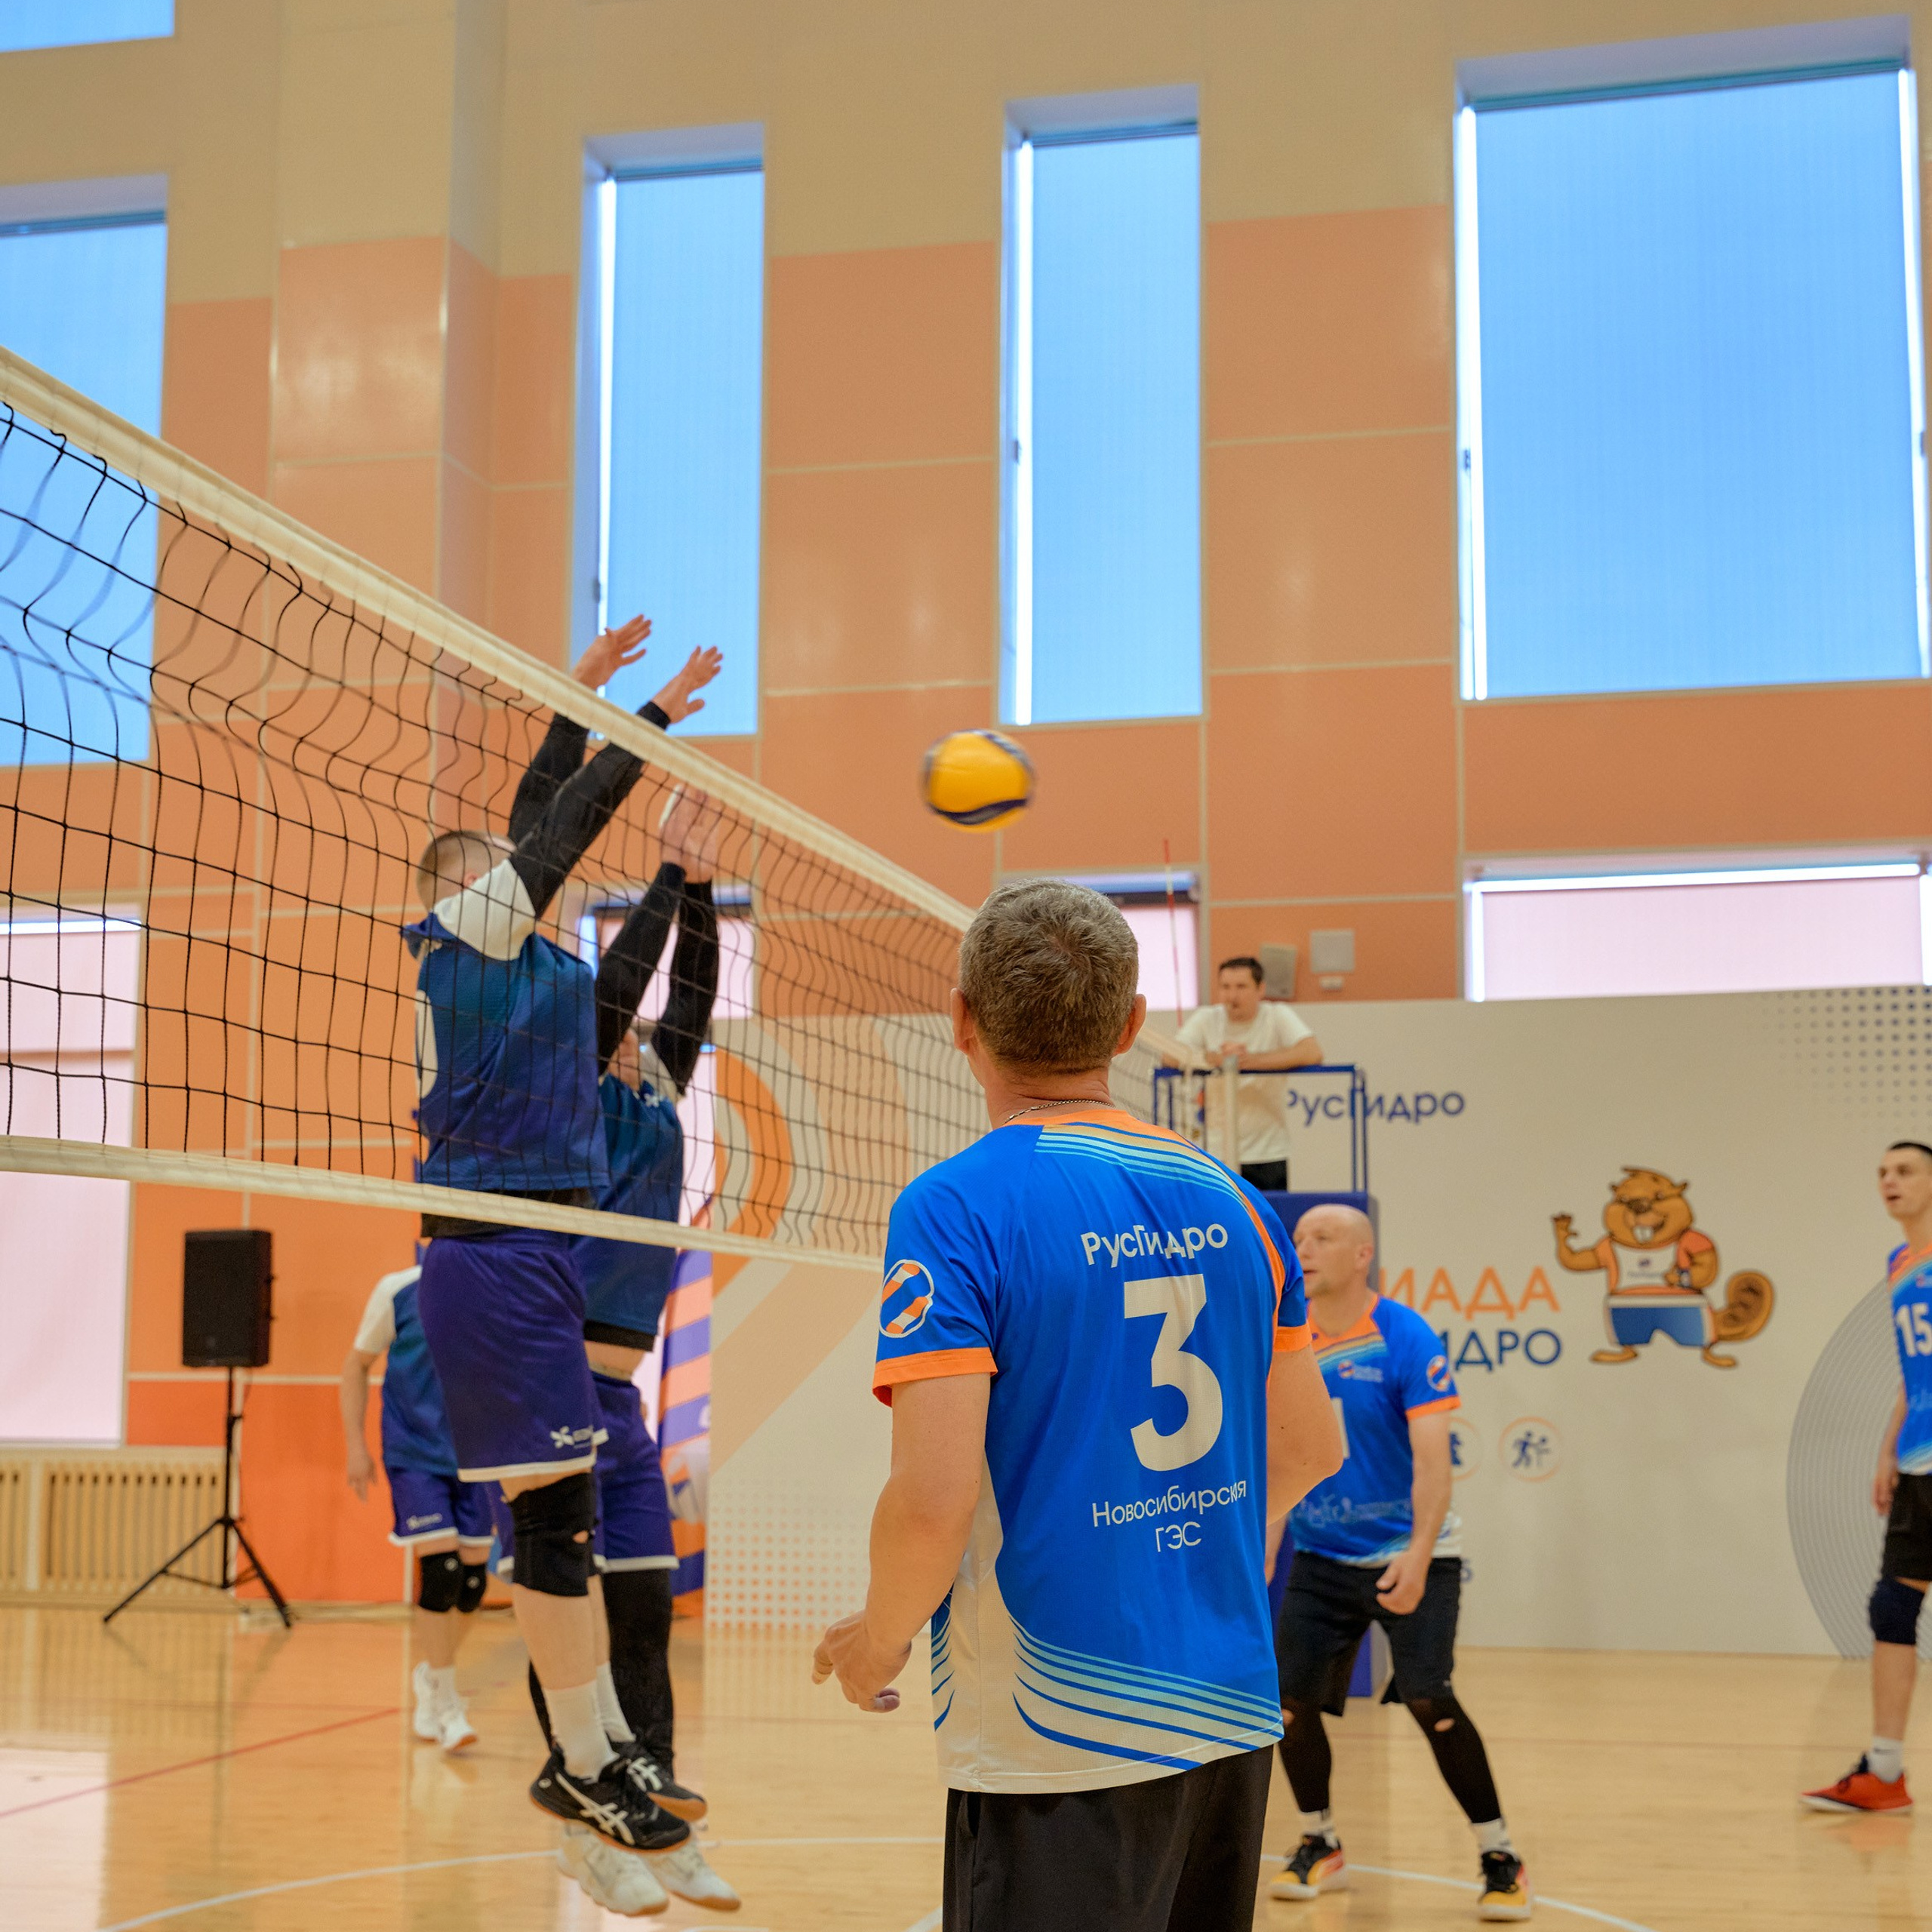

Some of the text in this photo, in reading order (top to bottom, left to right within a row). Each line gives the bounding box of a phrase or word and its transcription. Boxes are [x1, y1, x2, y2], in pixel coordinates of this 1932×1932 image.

[1081, 1223, 1228, 1268] РусГидро
[1380, 1266, 1561, 1321] ИАДА
[1897, 1303, 1932, 1357] 15
[1124, 1273, 1223, 1472] 3
[1155, 1521, 1202, 1552] ГЭС
